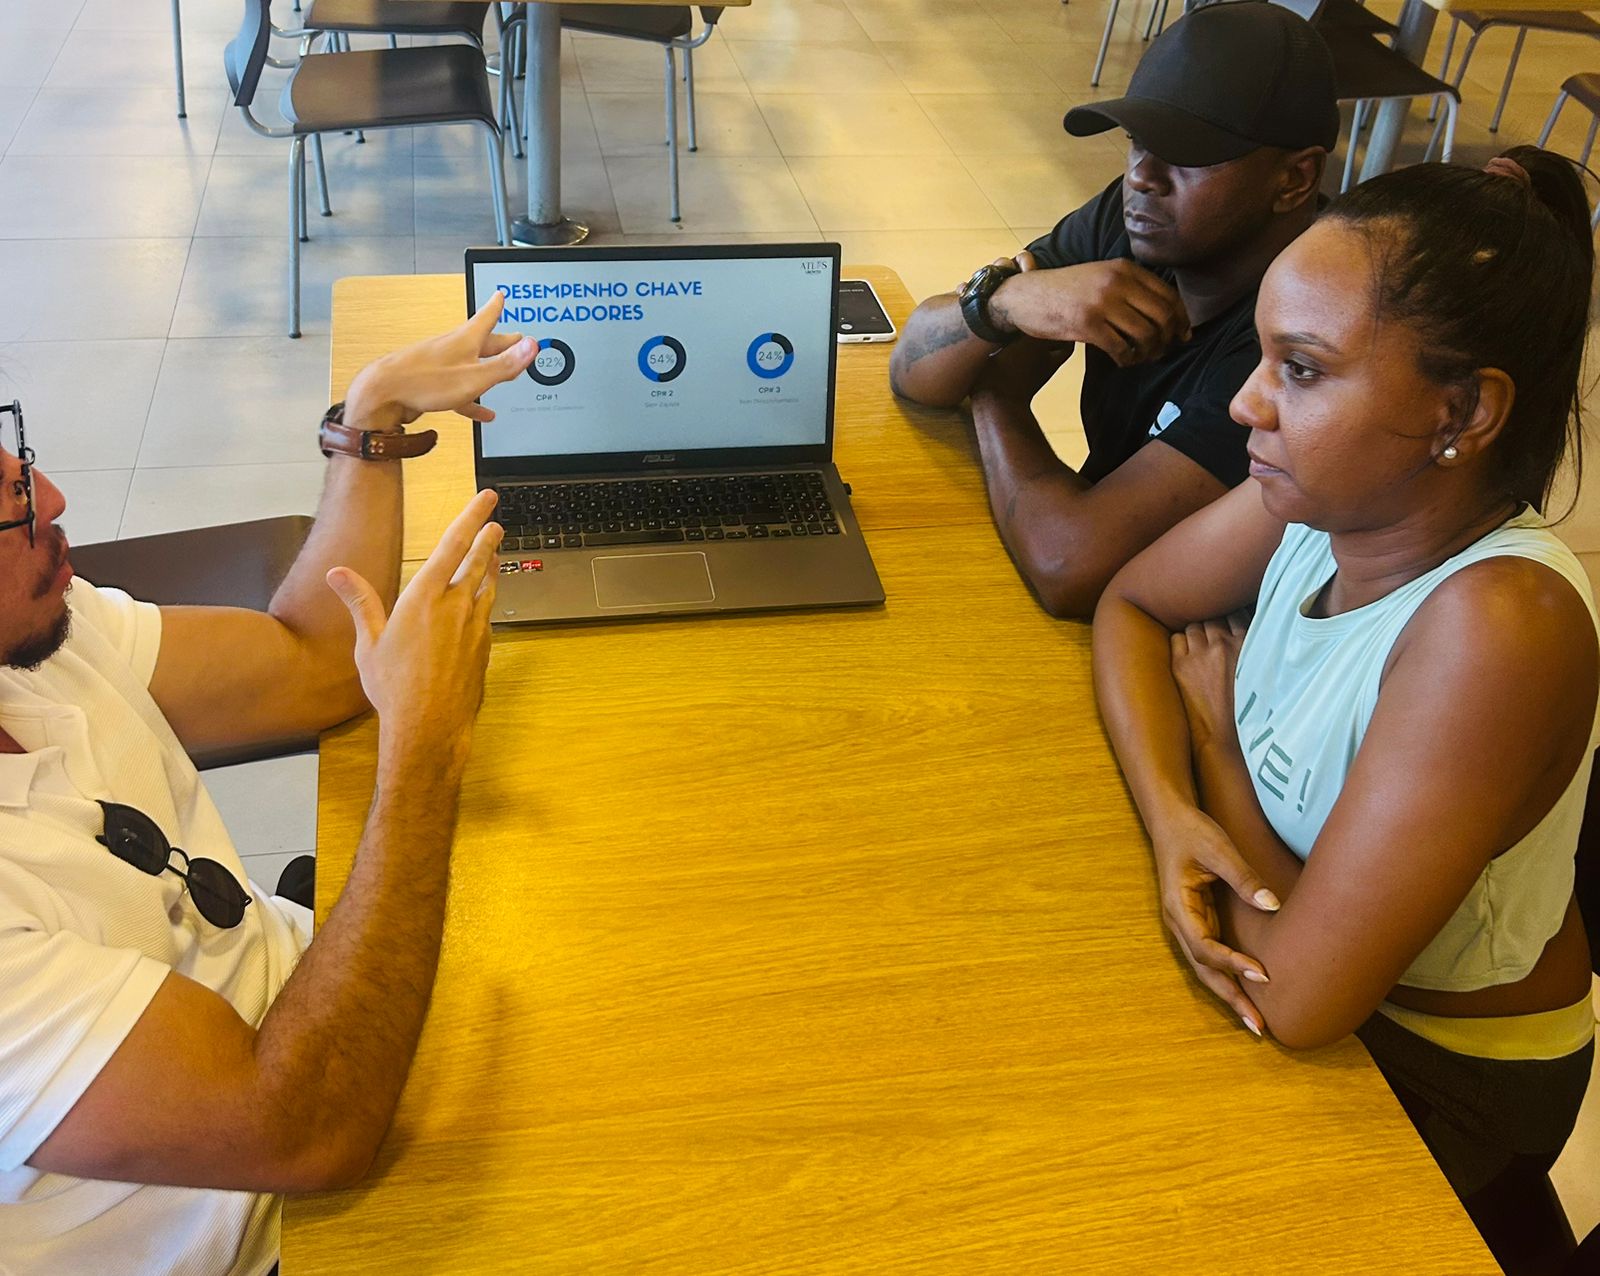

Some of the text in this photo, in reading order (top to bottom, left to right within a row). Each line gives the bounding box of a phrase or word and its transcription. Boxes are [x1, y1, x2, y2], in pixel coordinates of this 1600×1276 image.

[497, 281, 703, 300] DESEMPENHO CHAVE
[537, 356, 564, 368] 92%
[649, 354, 675, 365] 54%
[758, 350, 783, 362] 24%
